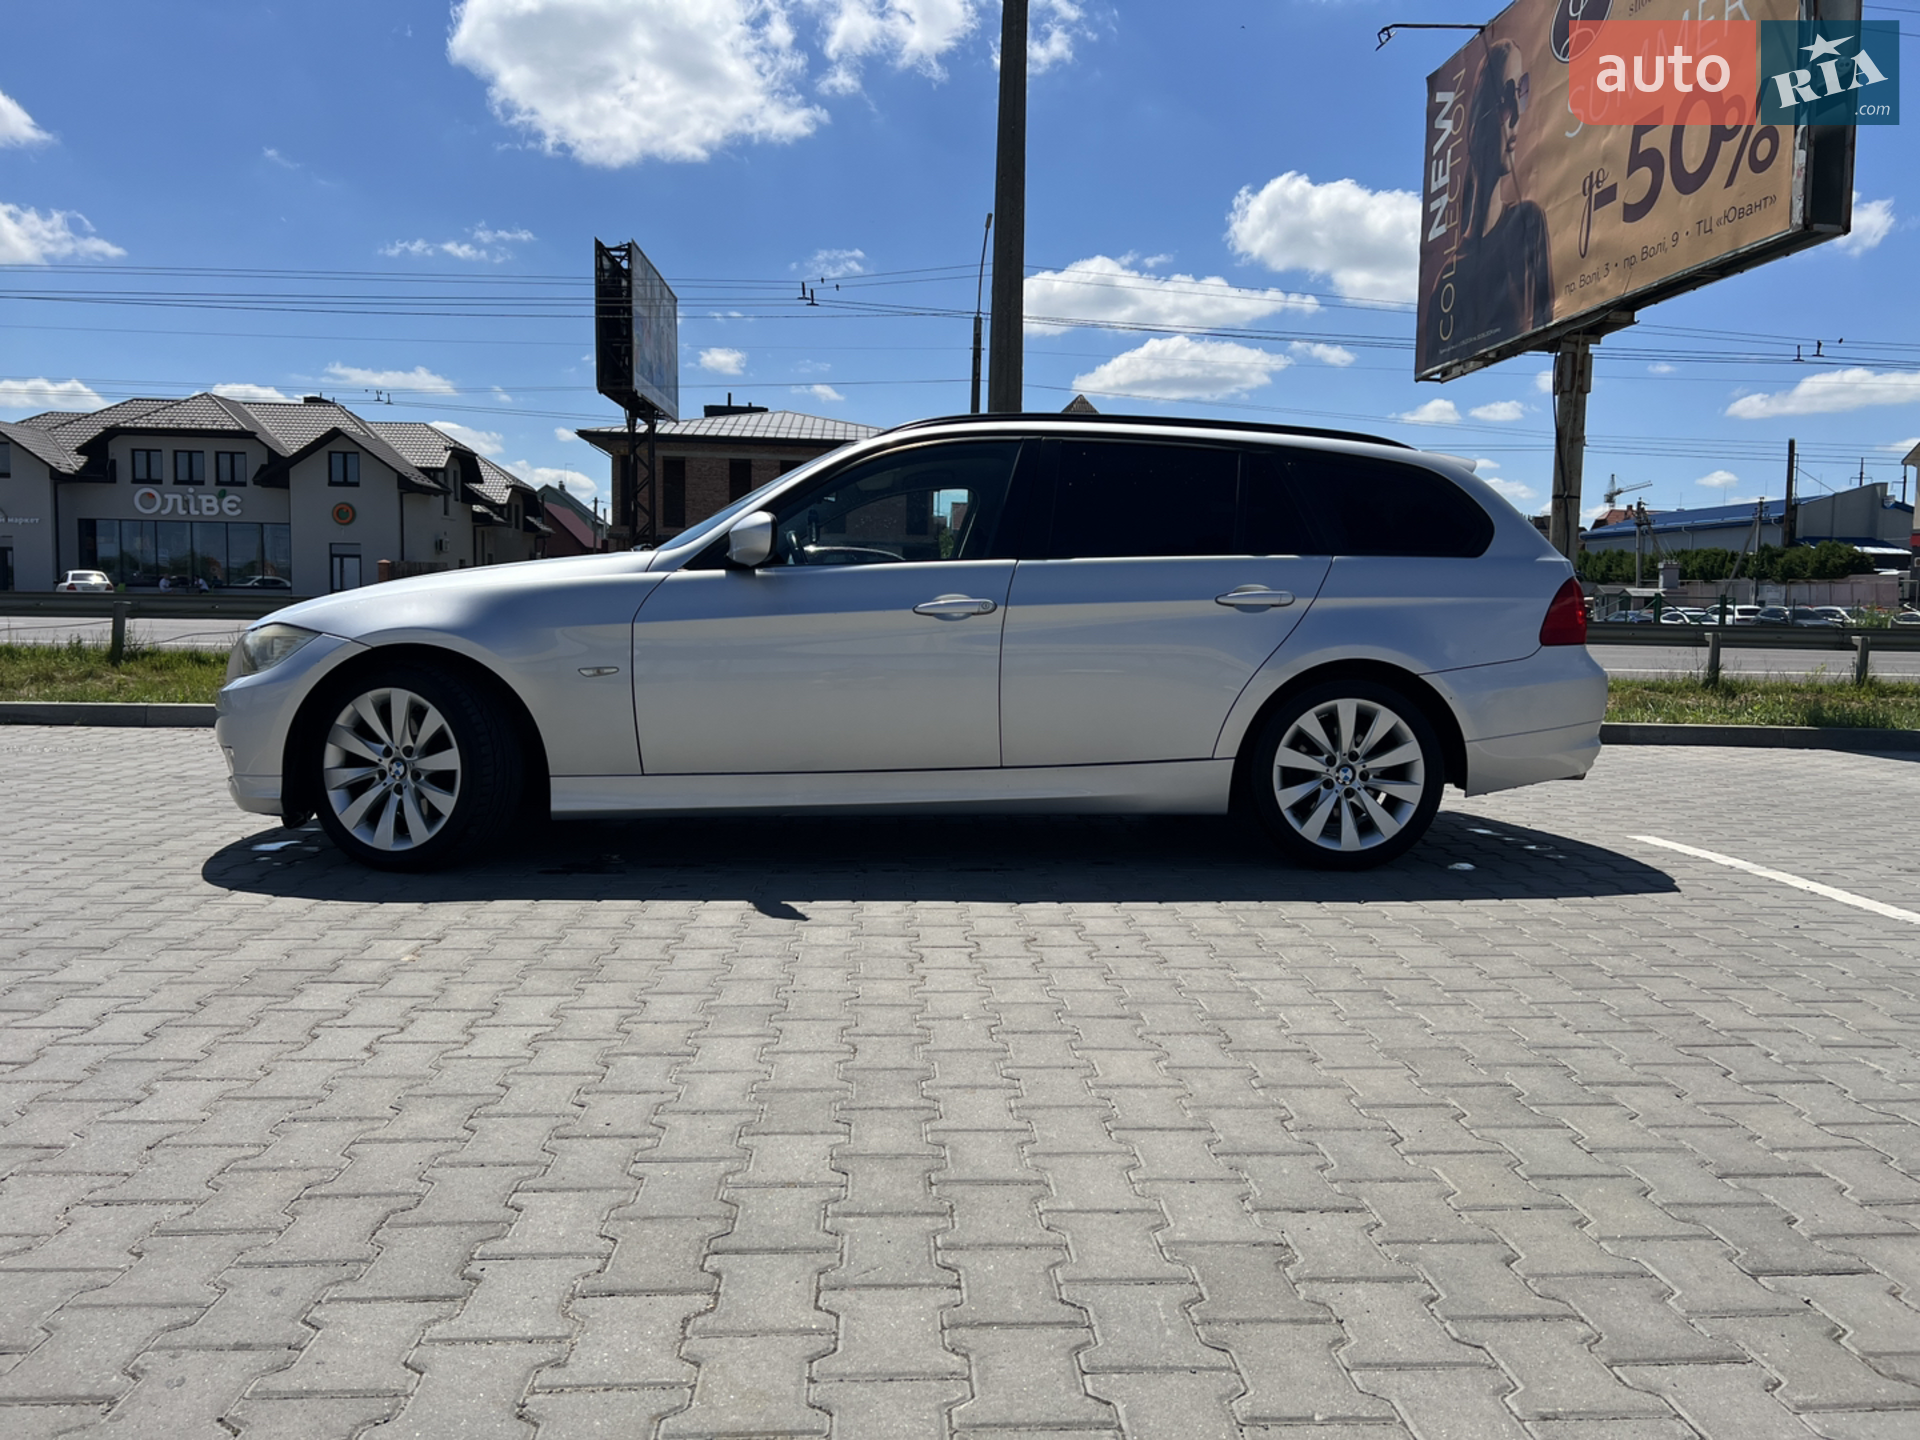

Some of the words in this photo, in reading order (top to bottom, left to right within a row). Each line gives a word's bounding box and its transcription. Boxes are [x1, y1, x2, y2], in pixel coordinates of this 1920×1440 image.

[1428, 91, 1455, 242] NEW
[1439, 68, 1466, 341] COLLECTION
[1593, 75, 1780, 224] -50%
[1603, 262, 1611, 279] 3
[1623, 255, 1638, 271] пр.
[1671, 231, 1680, 248] 9
[1696, 215, 1713, 237] ТЦ
[1716, 194, 1778, 226] «Ювант»
